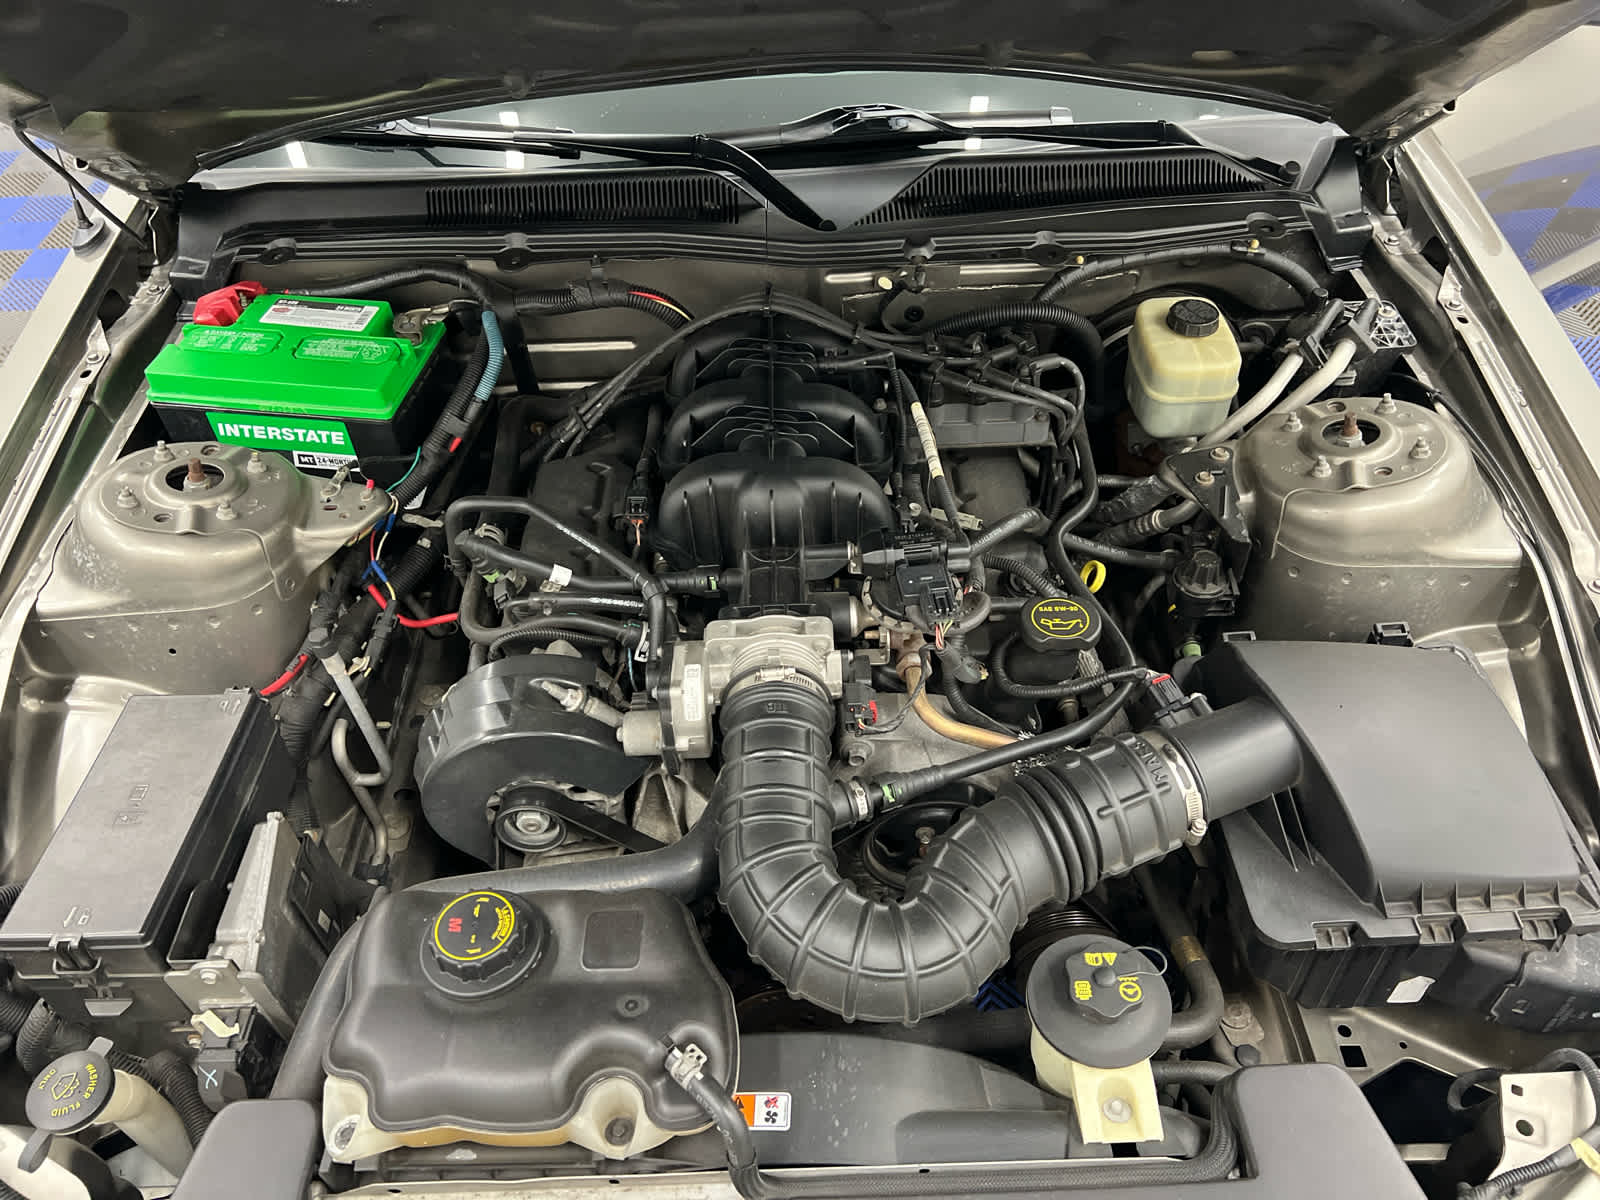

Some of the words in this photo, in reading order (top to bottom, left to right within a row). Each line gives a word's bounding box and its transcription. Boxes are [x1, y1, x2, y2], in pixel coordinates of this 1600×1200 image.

[217, 422, 345, 445] INTERSTATE
[299, 455, 315, 465] MT
[38, 1068, 57, 1090] ONLY
[83, 1063, 98, 1099] WASHER
[51, 1101, 81, 1117] FLUID
